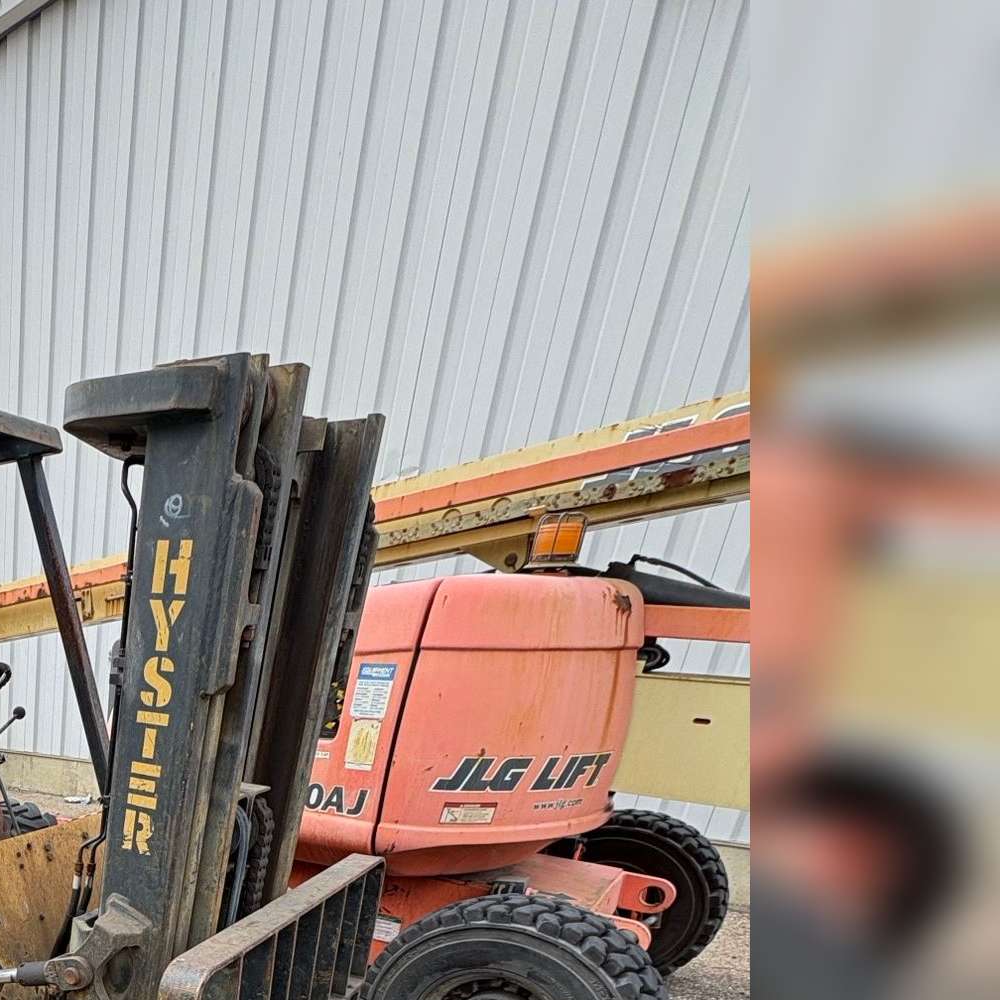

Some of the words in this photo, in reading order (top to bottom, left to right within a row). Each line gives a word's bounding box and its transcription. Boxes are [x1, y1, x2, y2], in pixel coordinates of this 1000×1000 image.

[121, 539, 194, 857] HYSTER
[429, 755, 534, 793] JLG
[529, 752, 613, 793] LIFT
